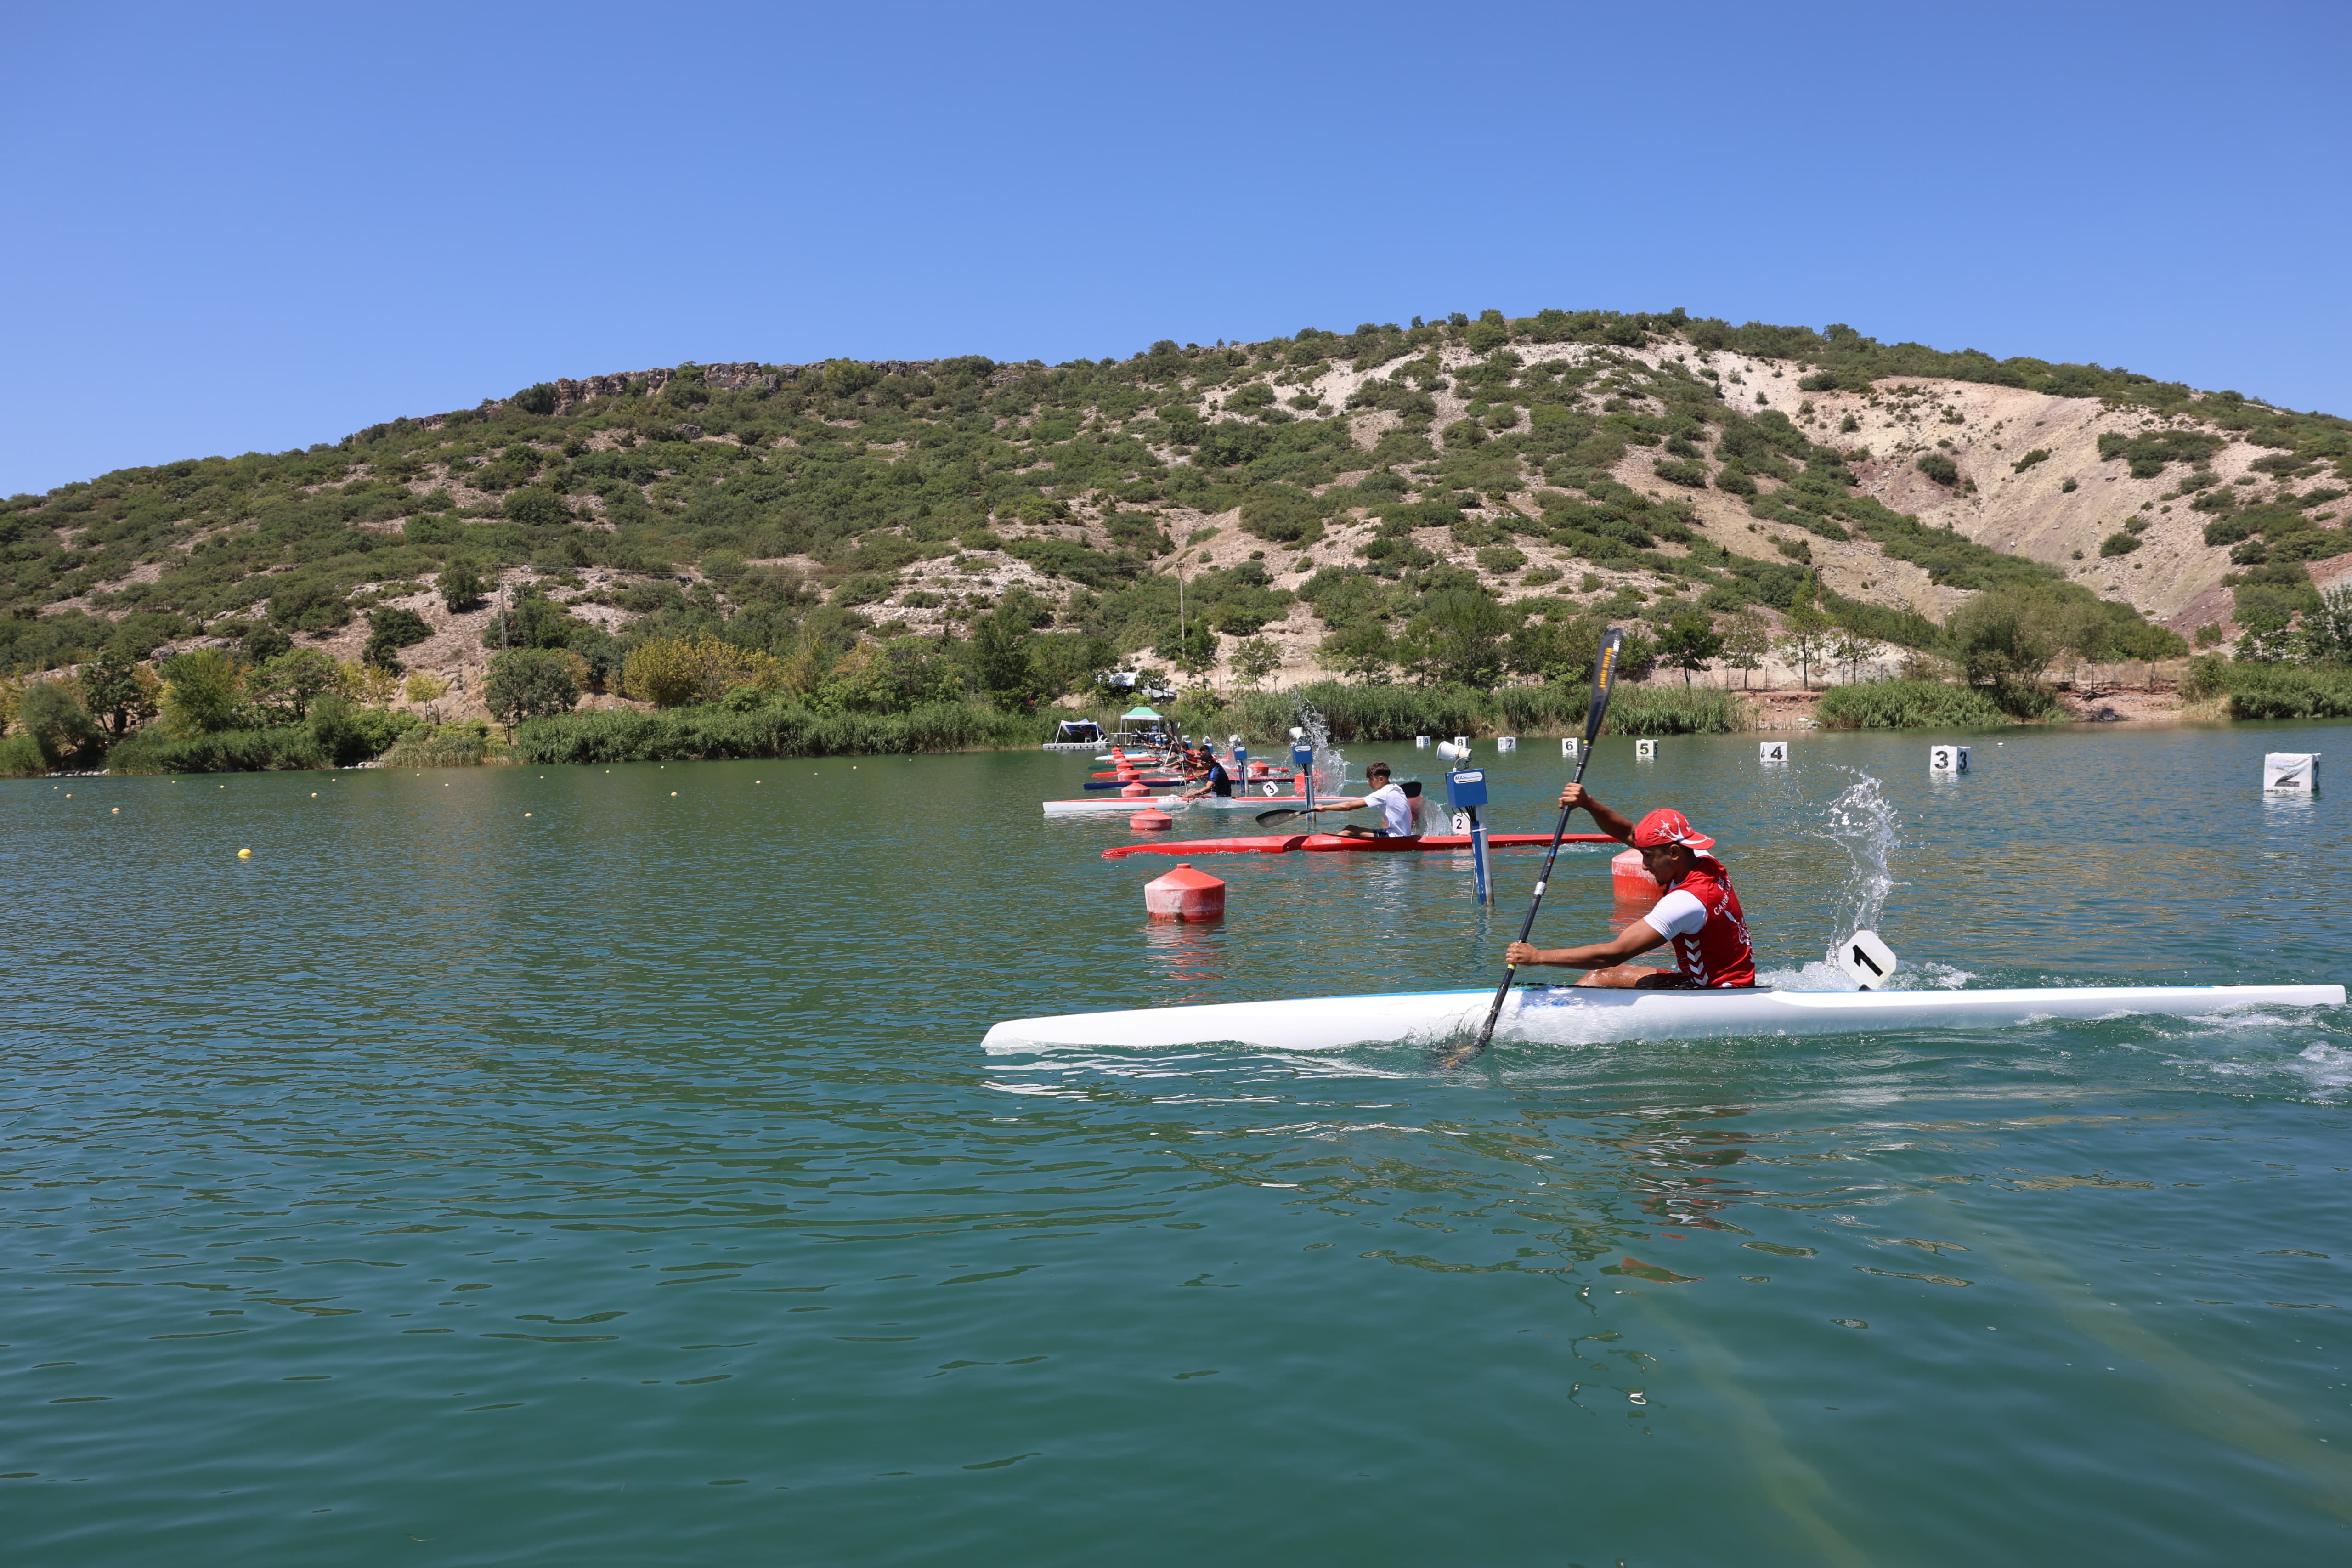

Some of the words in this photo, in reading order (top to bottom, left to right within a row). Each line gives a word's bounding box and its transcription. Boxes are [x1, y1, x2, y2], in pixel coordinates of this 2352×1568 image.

[1508, 739, 1513, 748] 7
[1566, 741, 1573, 750] 6
[1640, 743, 1649, 754] 5
[1654, 743, 1658, 754] 5
[1761, 746, 1765, 760] 4
[1770, 746, 1783, 760] 4
[1934, 751, 1948, 769] 3
[1959, 751, 1967, 770] 3
[1266, 785, 1274, 793] 3
[1456, 819, 1462, 829] 2
[1852, 945, 1883, 977] 1
